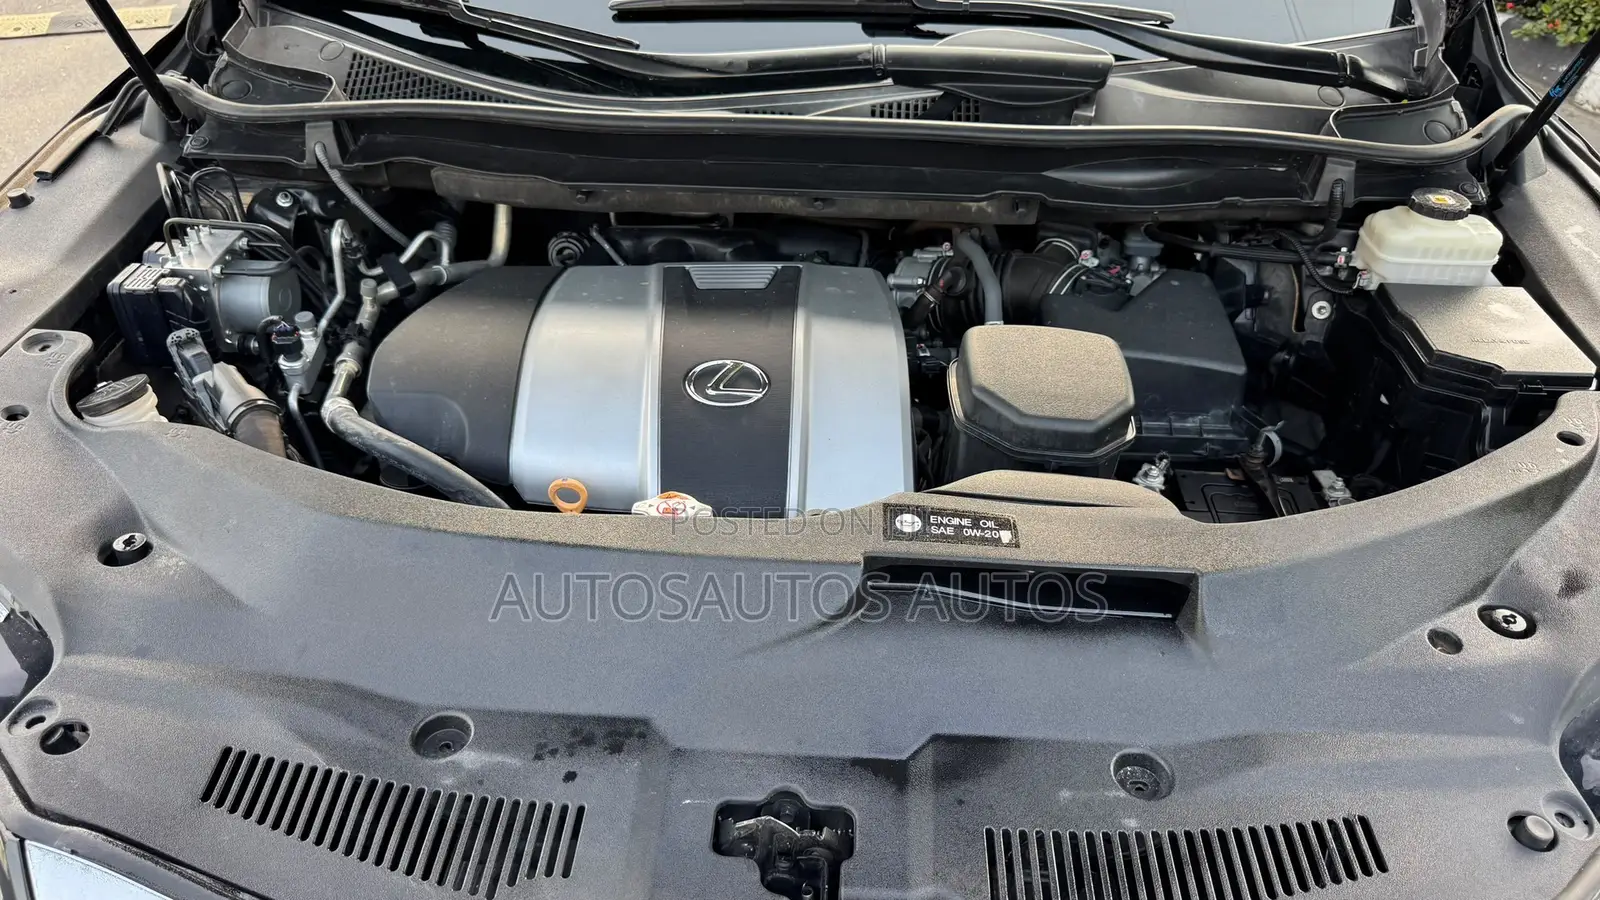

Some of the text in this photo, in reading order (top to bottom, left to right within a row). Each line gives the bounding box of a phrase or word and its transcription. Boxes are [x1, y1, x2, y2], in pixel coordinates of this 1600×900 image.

[929, 515, 1000, 529] ENGINE OIL
[930, 525, 1000, 539] SAE 0W-20
